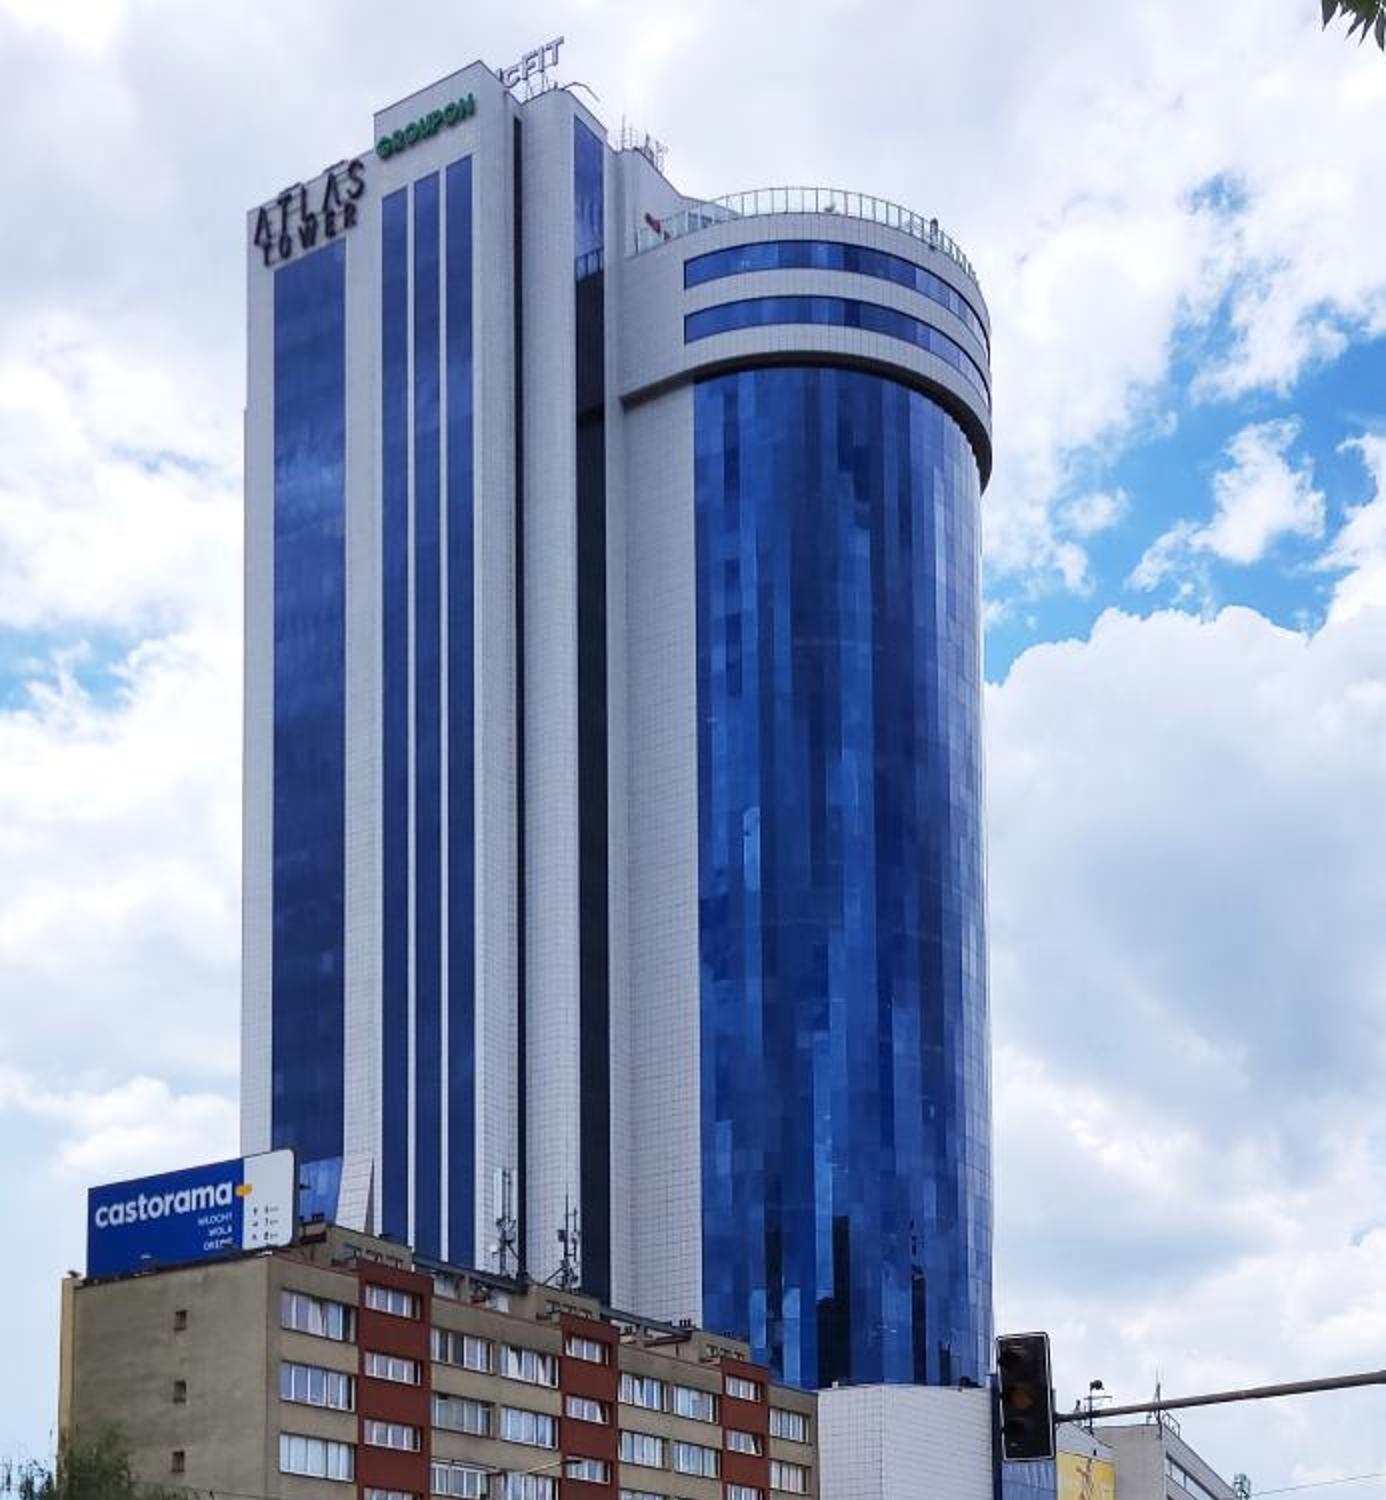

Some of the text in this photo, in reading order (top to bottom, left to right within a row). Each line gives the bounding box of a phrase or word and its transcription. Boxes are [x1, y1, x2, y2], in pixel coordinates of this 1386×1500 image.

[376, 93, 477, 160] GROUPON
[254, 159, 366, 246] ATLAS
[260, 203, 358, 268] TOWER
[95, 1181, 233, 1227] castorama
